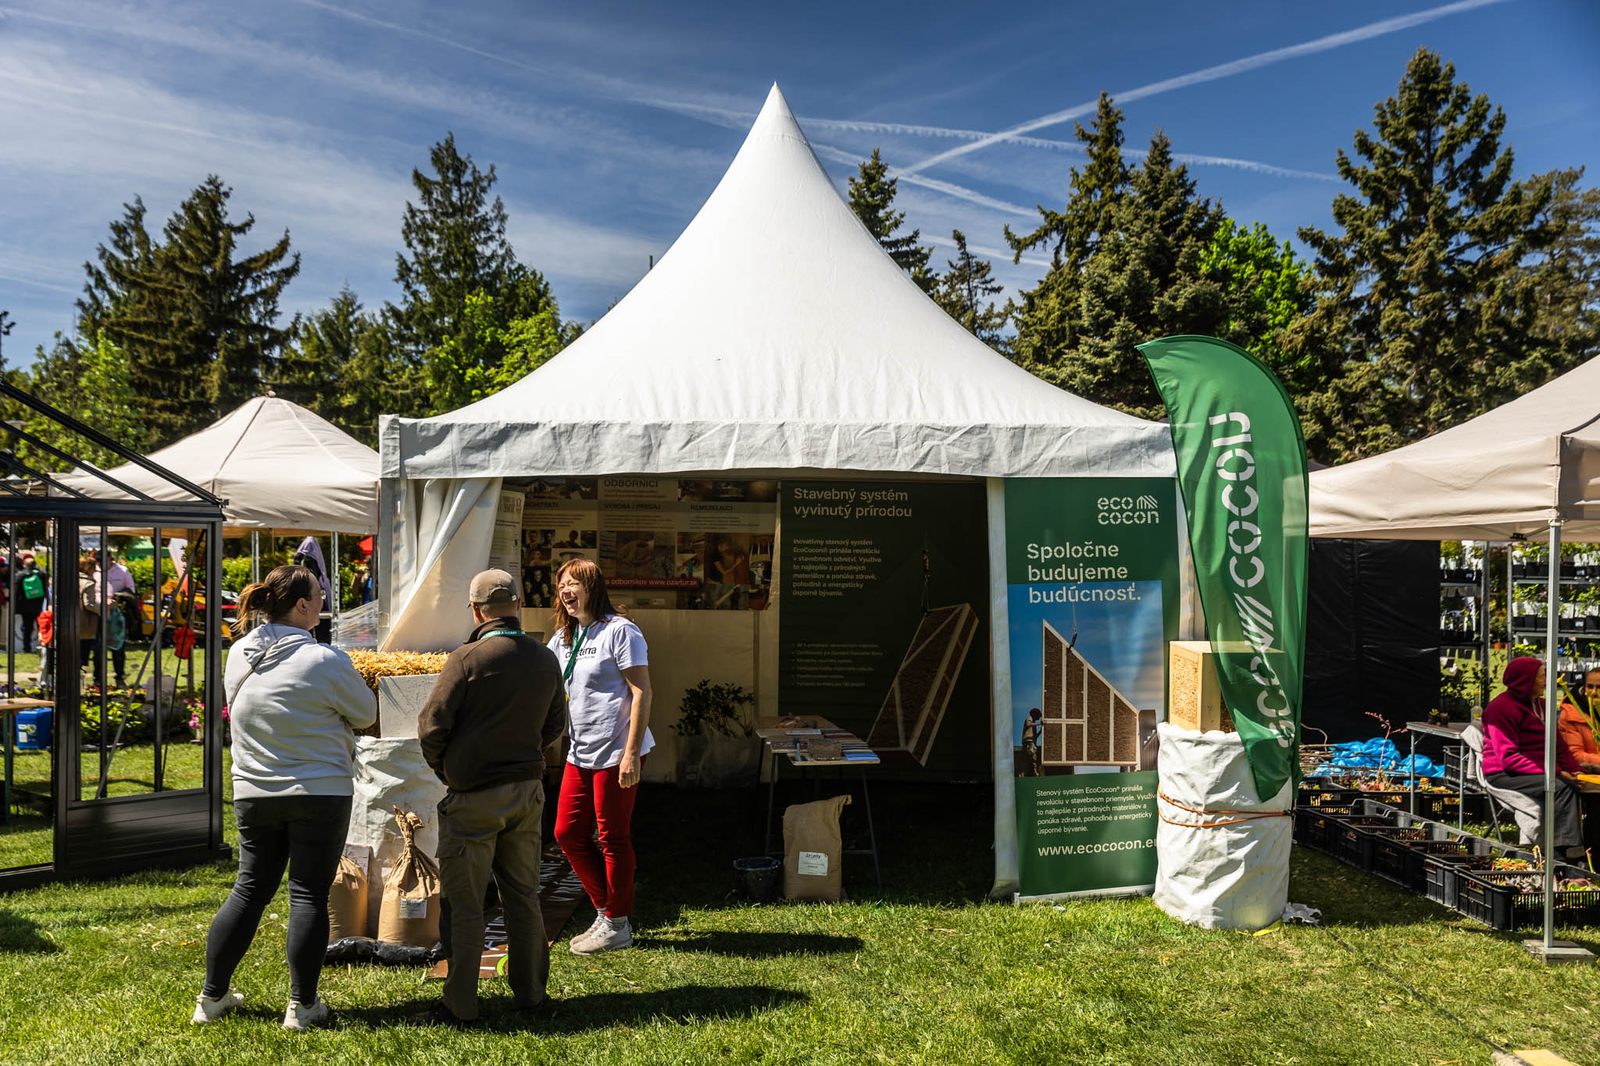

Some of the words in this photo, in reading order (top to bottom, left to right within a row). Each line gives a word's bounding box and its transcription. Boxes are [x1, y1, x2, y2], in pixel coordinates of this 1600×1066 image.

[794, 487, 856, 503] Stavebný
[860, 489, 908, 503] systém
[1097, 496, 1133, 510] eco
[794, 503, 851, 519] vyvinutý
[856, 505, 912, 519] prírodou
[1097, 511, 1159, 525] cocon
[1027, 541, 1119, 563] Spoločne
[1028, 563, 1128, 584] budujeme
[1029, 582, 1141, 604] budúcnosť.
[1036, 788, 1061, 797] Stenový
[1062, 787, 1085, 796] systém
[1122, 785, 1143, 794] prináša
[1037, 798, 1064, 807] revolúciu
[1071, 796, 1104, 804] stavebnom
[1044, 807, 1071, 816] najlepšie
[1077, 805, 1111, 814] prírodných
[1112, 803, 1142, 812] materiálov
[1037, 816, 1060, 826] ponúka
[1084, 814, 1113, 824] pohodlné
[1119, 811, 1153, 820] energeticky
[1037, 825, 1063, 835] úsporné
